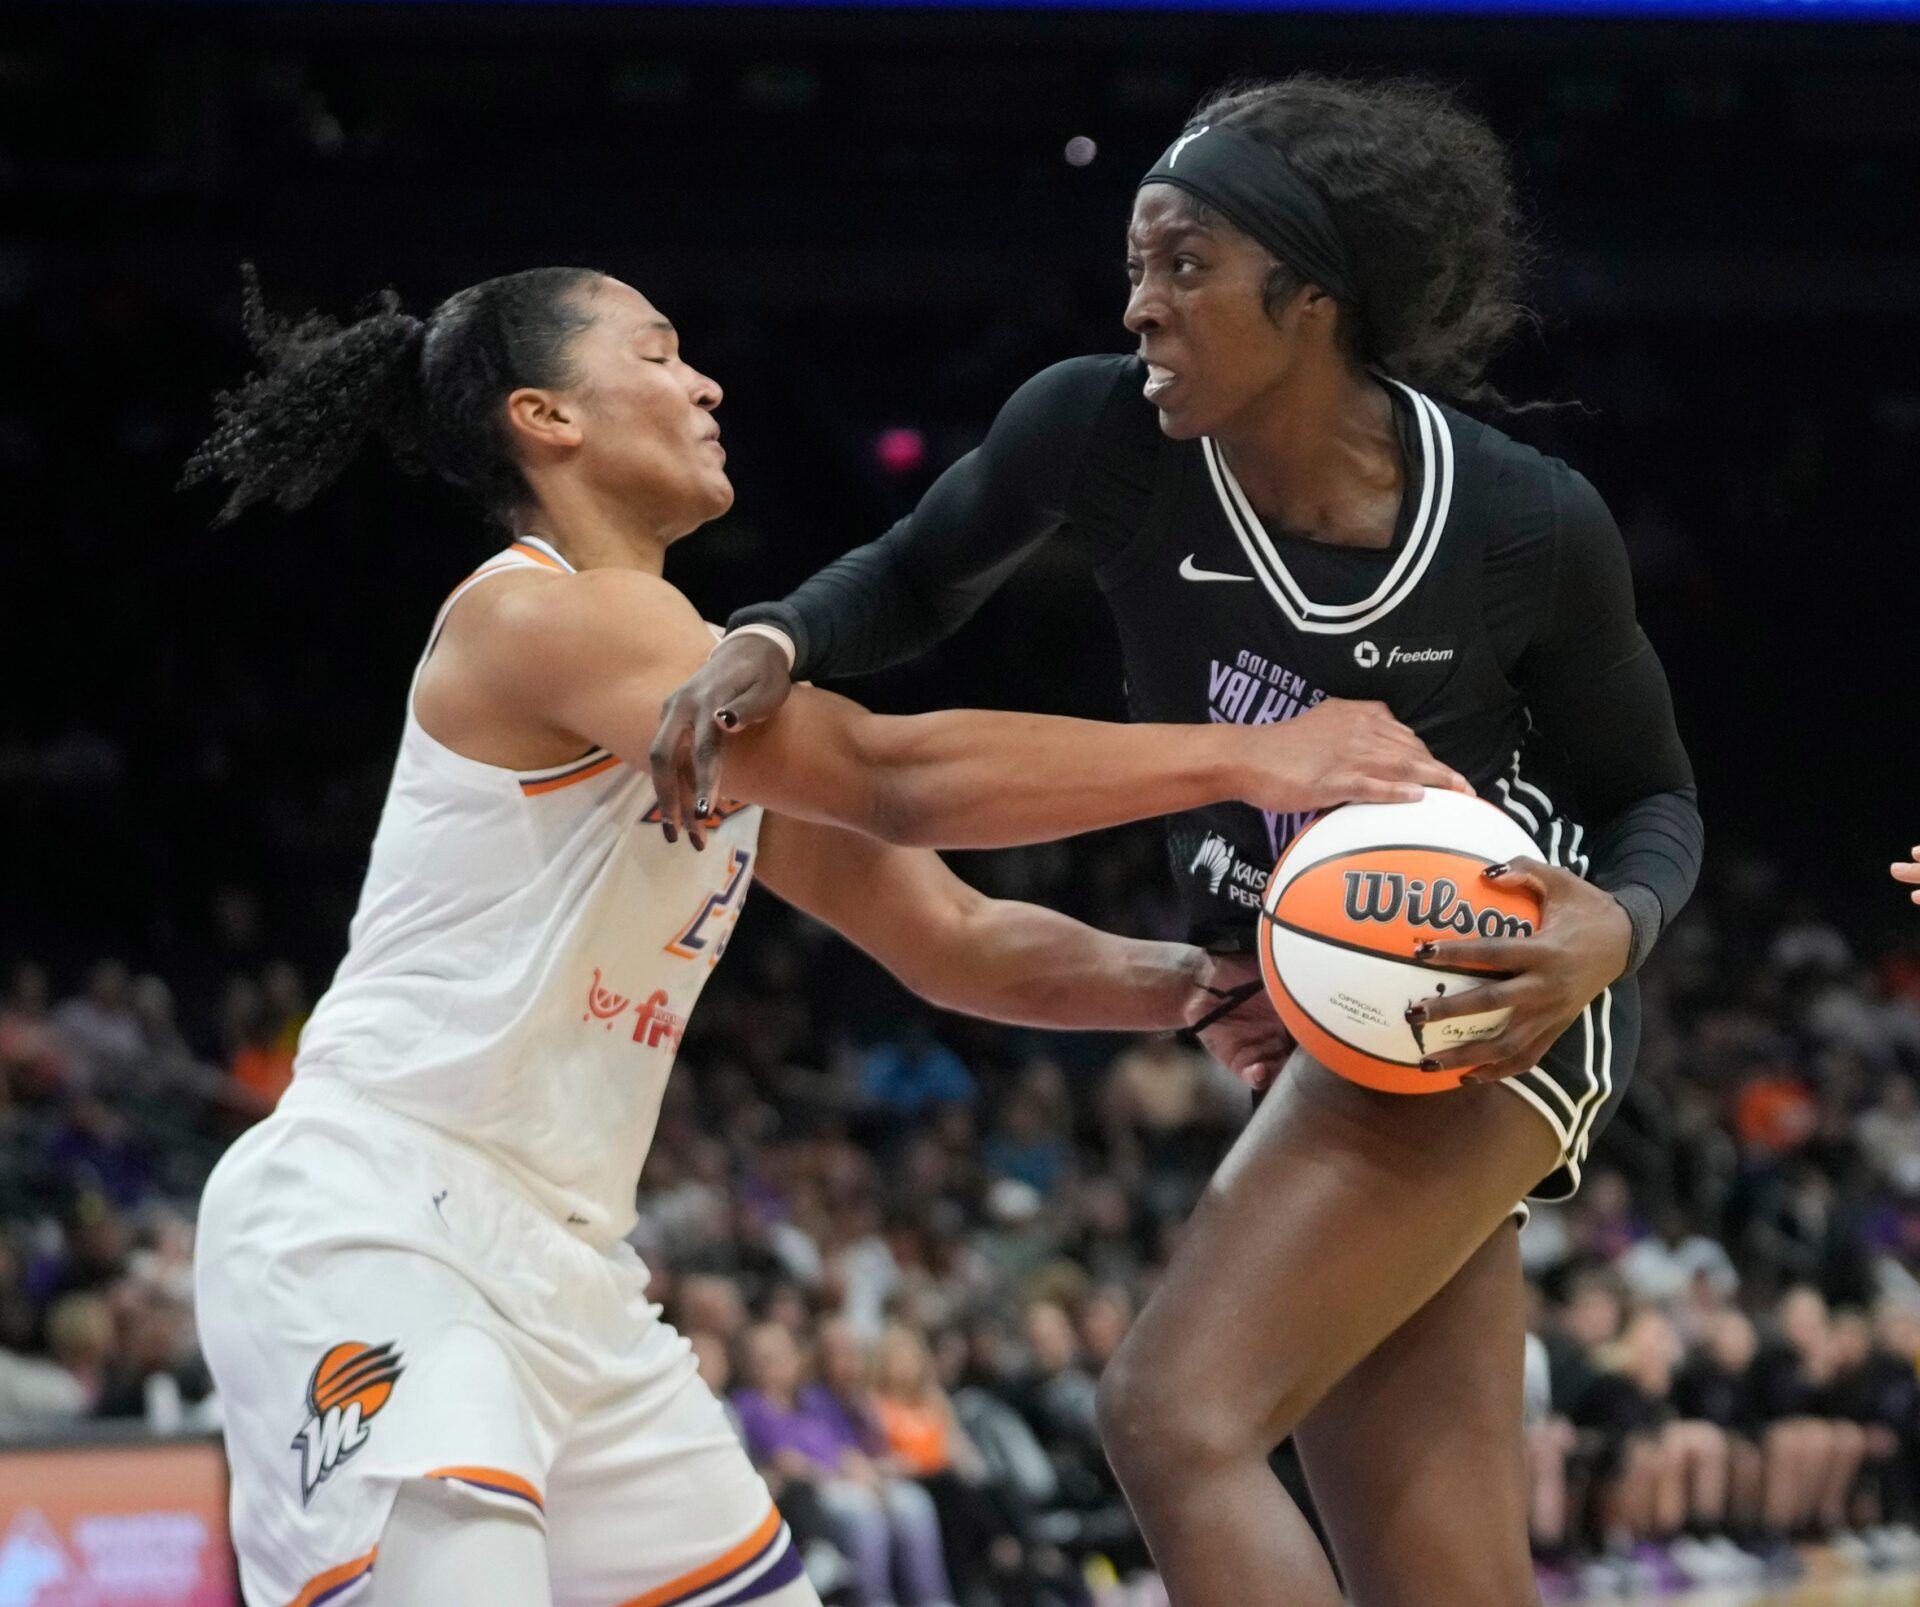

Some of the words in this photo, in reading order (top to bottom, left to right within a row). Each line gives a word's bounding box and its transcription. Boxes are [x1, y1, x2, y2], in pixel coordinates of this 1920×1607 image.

[1386, 645, 1454, 668] freedom
[1236, 649, 1307, 698] GOLDEN
[1231, 859, 1273, 890] KAIS
[1343, 871, 1534, 940] Wilson
[1329, 997, 1360, 1016] GAME
[1361, 1011, 1392, 1028] BALL
[1338, 992, 1385, 1017] OFFICIAL
